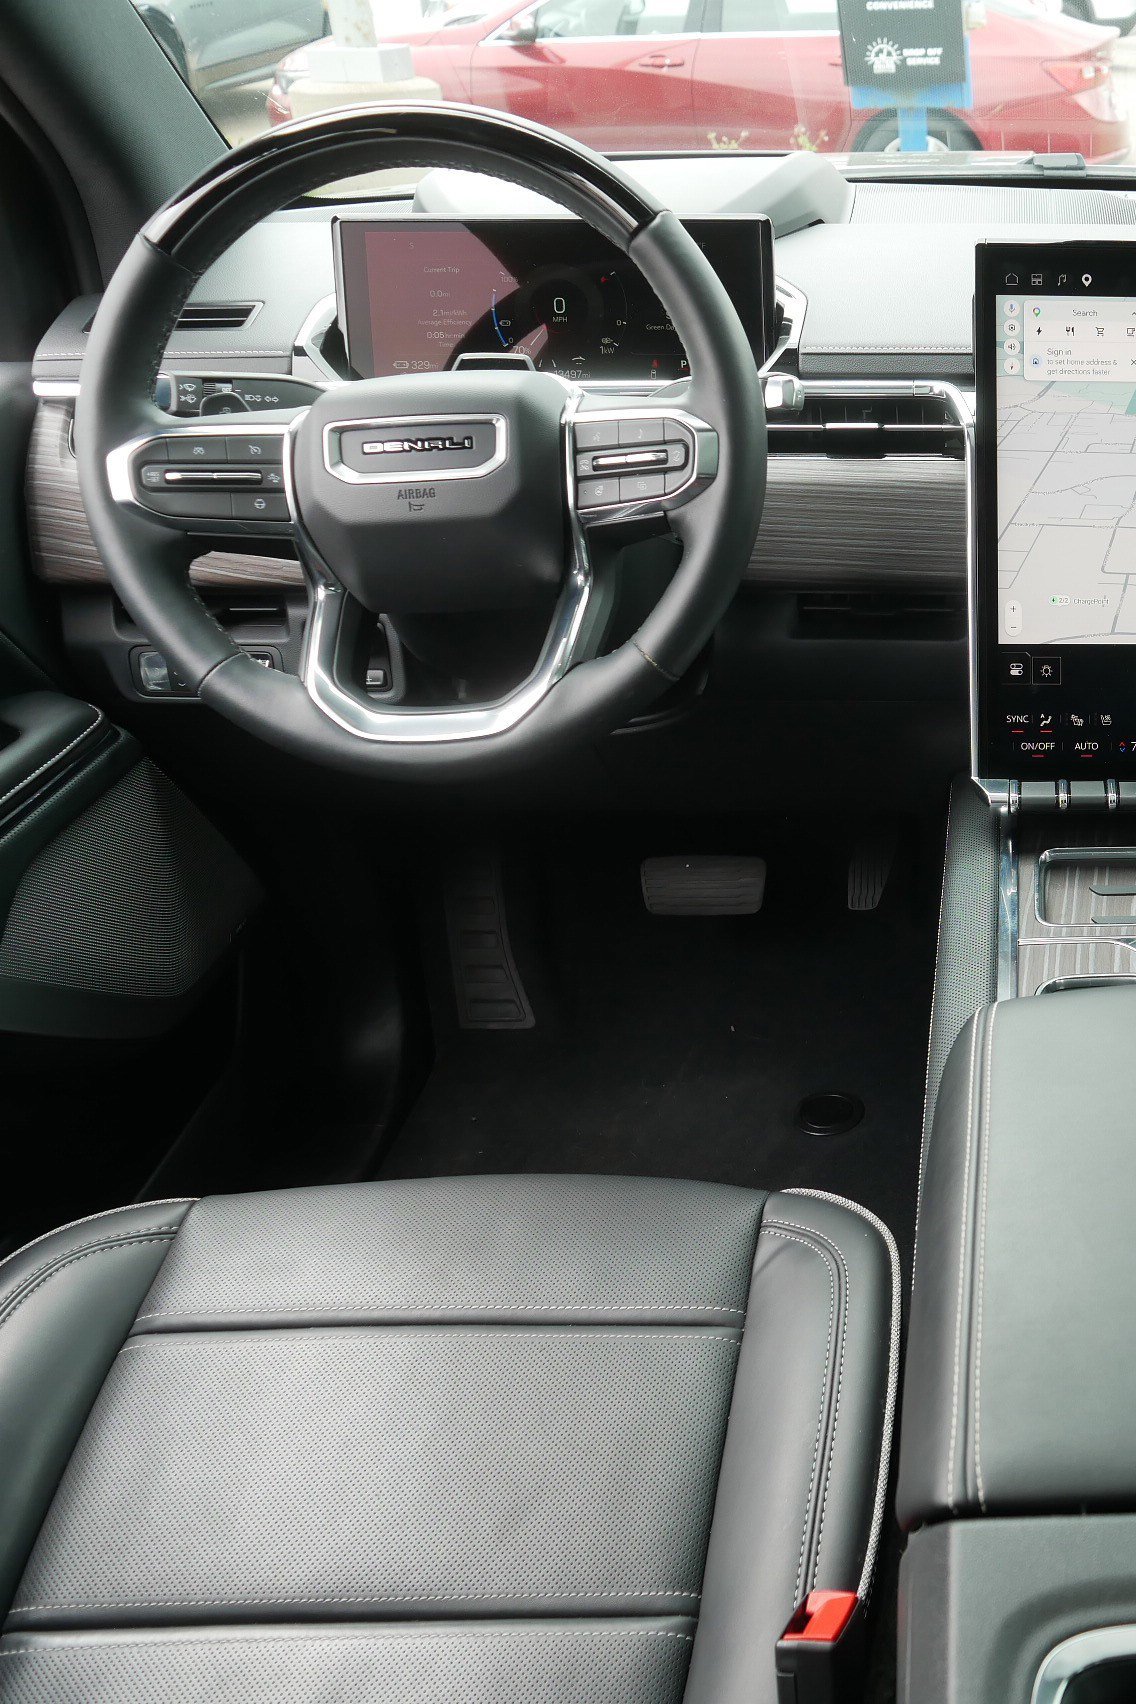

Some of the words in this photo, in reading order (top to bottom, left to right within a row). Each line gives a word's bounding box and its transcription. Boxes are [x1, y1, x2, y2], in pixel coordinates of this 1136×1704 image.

[447, 266, 460, 275] Trip
[553, 297, 566, 314] 0
[1072, 309, 1098, 317] Search
[417, 319, 442, 327] Average
[1046, 348, 1064, 357] Sign
[1046, 368, 1058, 376] get
[362, 436, 474, 455] DENALI
[397, 488, 436, 500] AIRBAG
[1006, 715, 1029, 723] SYNC
[1020, 742, 1055, 751] ON/OFF
[1074, 742, 1099, 750] AUTO
